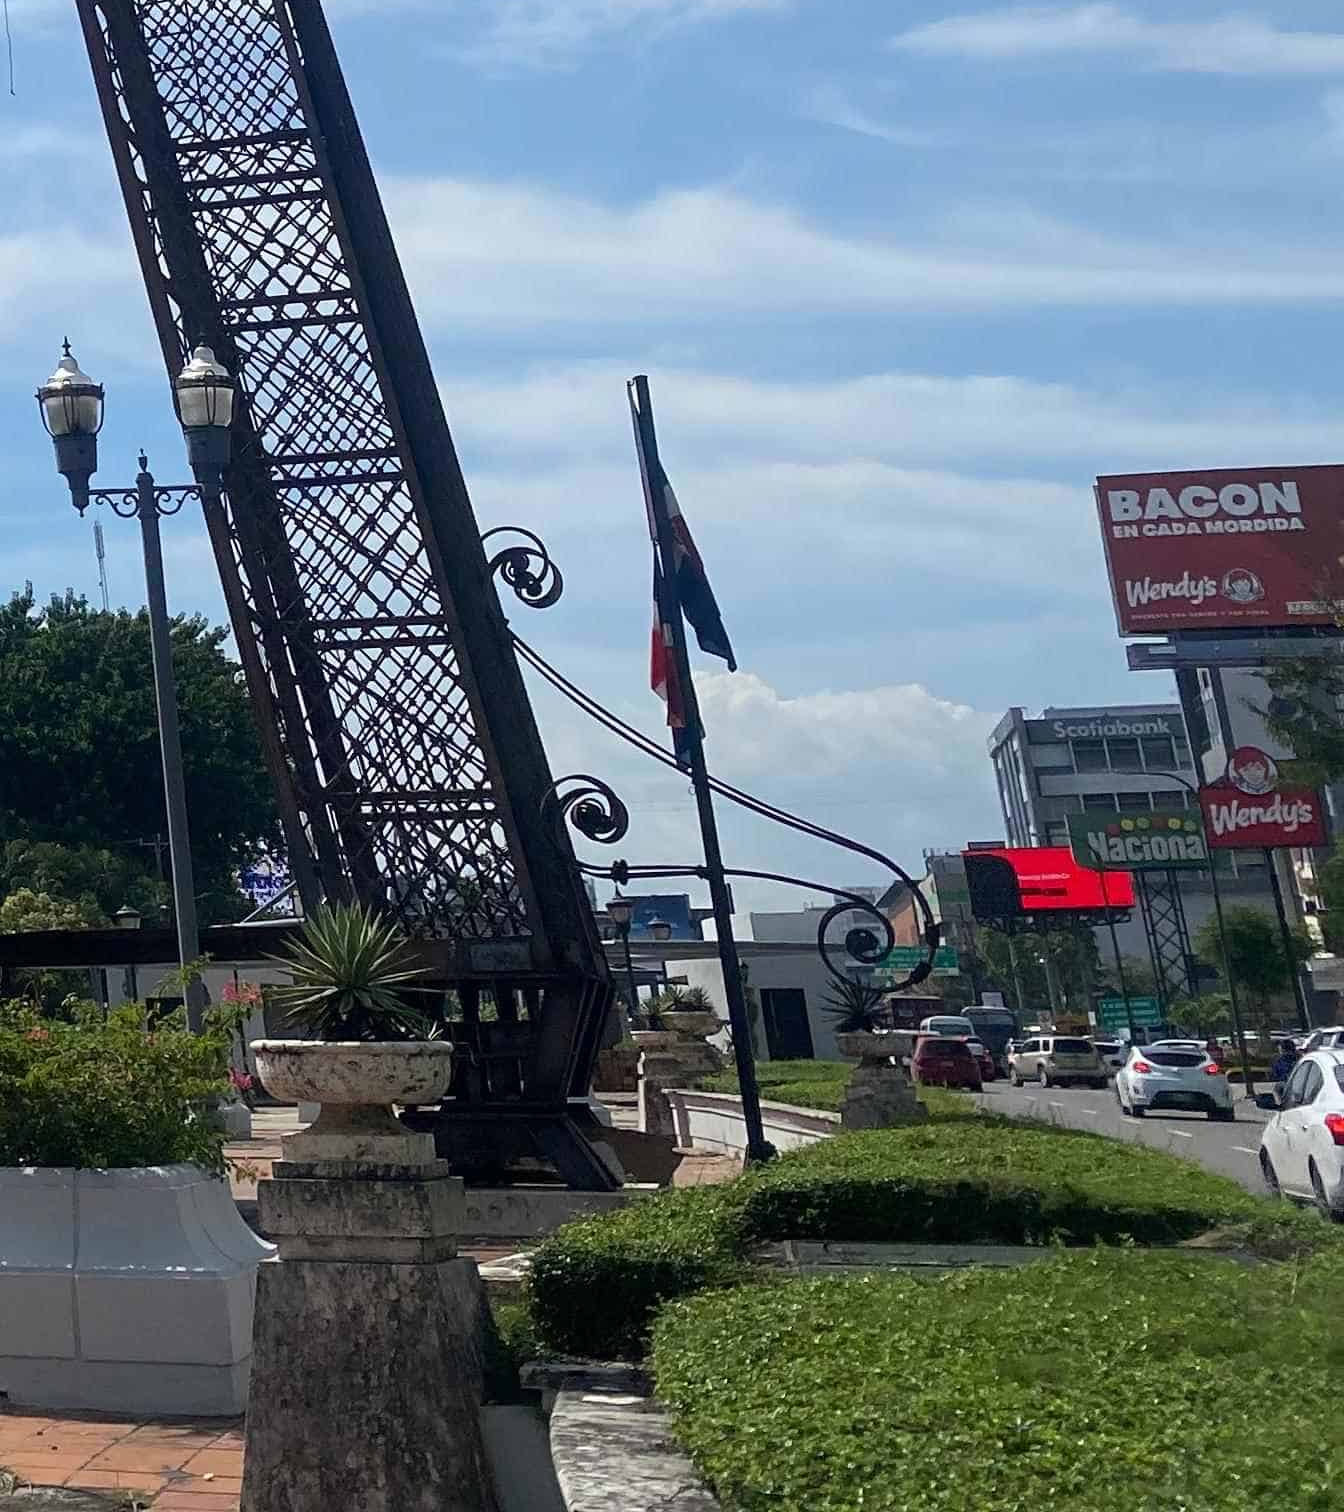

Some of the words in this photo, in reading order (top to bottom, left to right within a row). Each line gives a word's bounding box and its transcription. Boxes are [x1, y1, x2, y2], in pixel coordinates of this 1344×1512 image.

[1108, 481, 1301, 522] BACON
[1113, 525, 1139, 538] EN
[1143, 521, 1202, 537] CADA
[1205, 517, 1305, 534] MORDIDA
[1125, 571, 1217, 608] Wendy's
[1053, 719, 1170, 738] Scotiabank
[1211, 797, 1313, 836] Wendy's
[1087, 832, 1206, 863] Naciona
